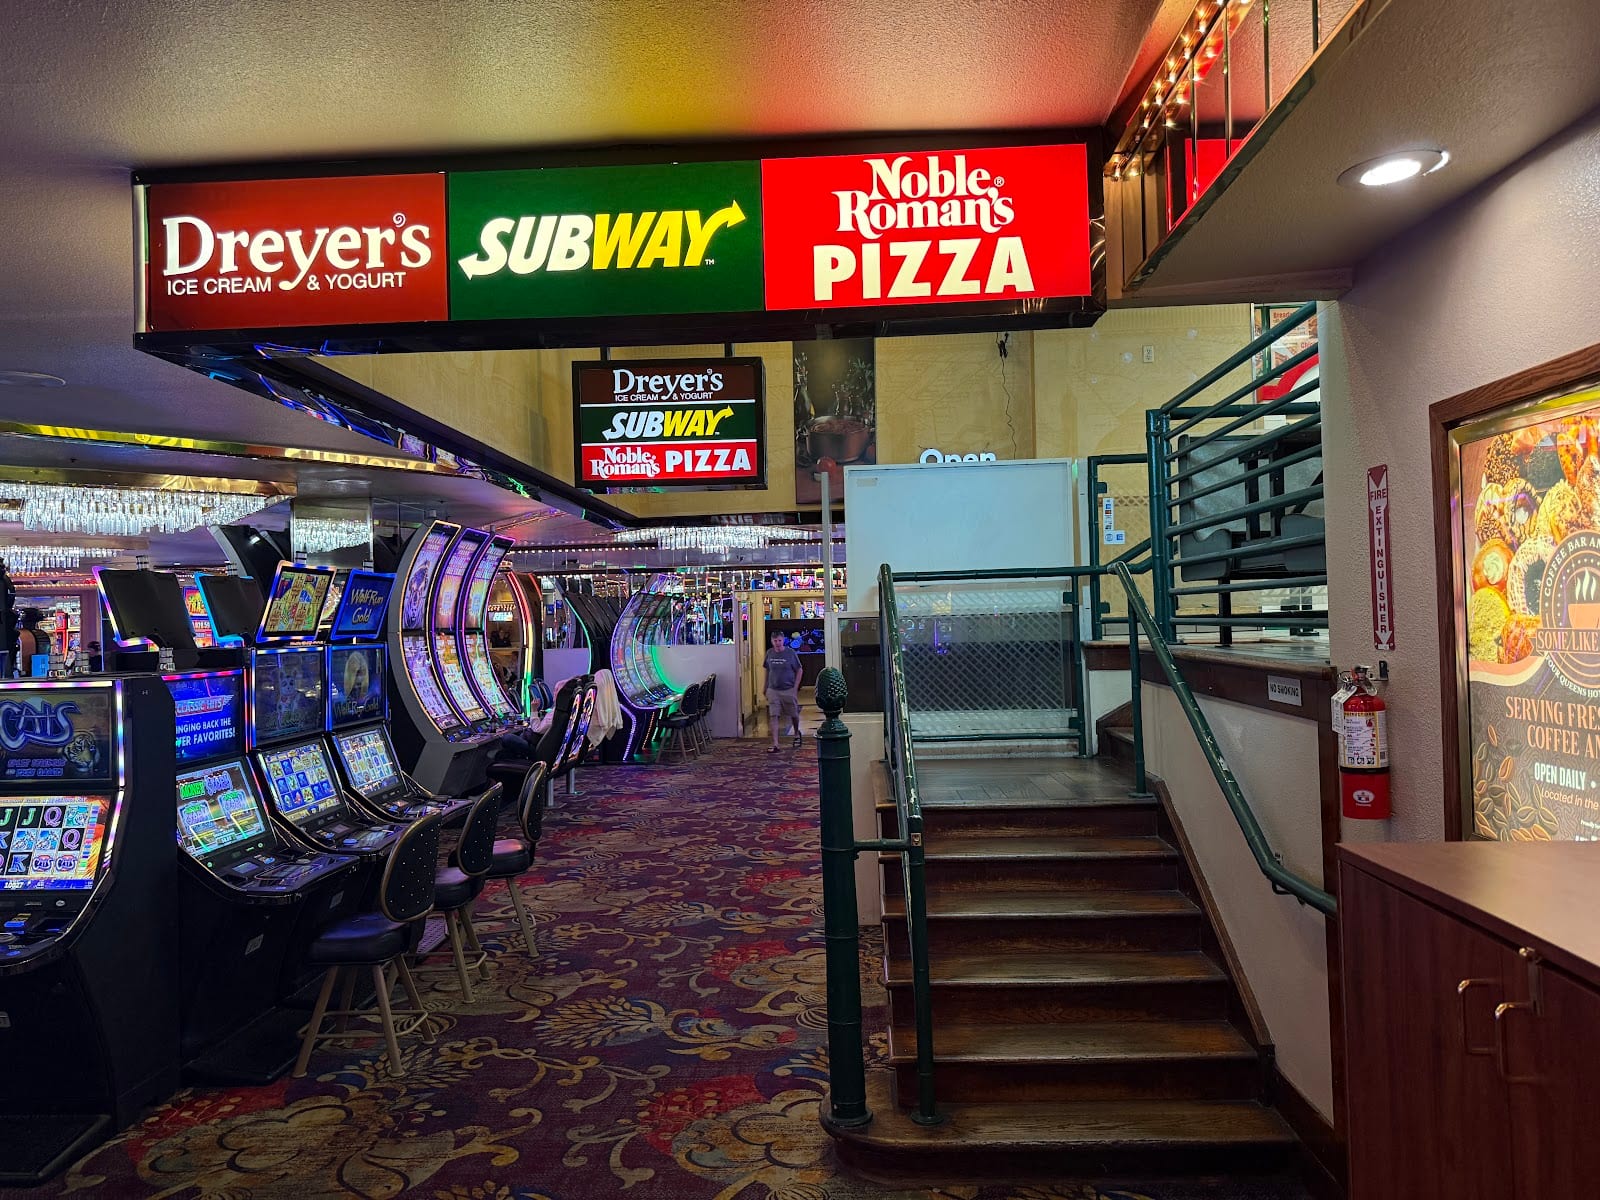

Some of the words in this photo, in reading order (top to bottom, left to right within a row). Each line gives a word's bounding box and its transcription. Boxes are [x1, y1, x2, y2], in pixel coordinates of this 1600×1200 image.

[863, 155, 991, 200] Noble
[831, 187, 1015, 240] Roman's
[162, 212, 432, 291] Dreyer's
[457, 199, 747, 281] SUBWAY
[813, 236, 1035, 302] PIZZA
[167, 280, 198, 296] ICE
[203, 276, 272, 295] CREAM
[306, 275, 320, 291] &
[325, 272, 407, 290] YOGURT
[613, 368, 724, 401] Dreyer's
[615, 394, 628, 402] ICE
[630, 393, 659, 402] CREAM
[672, 392, 679, 401] &
[680, 392, 713, 400] YOGURT
[602, 405, 735, 441] SUBWAY
[602, 447, 652, 463] Noble
[665, 448, 752, 473] PIZZA
[589, 460, 661, 479] Roman's
[1370, 488, 1387, 500] FIRE
[1375, 505, 1387, 634] EXTINGUISHER
[1544, 548, 1567, 597] COFFEE
[1568, 537, 1587, 552] BAR
[352, 607, 372, 624] Gold
[1537, 631, 1568, 650] SOME
[1571, 631, 1599, 652] LIKE
[1560, 675, 1587, 697] QUEENS
[203, 719, 219, 730] BACK
[220, 717, 232, 727] THE
[1505, 696, 1564, 725] SERVING
[193, 726, 236, 744] FAVORITES!
[1527, 724, 1580, 756] COFFEE
[1534, 762, 1558, 785] OPEN
[1559, 767, 1587, 791] DAILY
[1541, 787, 1573, 804] Located
[1575, 794, 1583, 807] in
[1584, 797, 1599, 810] the
